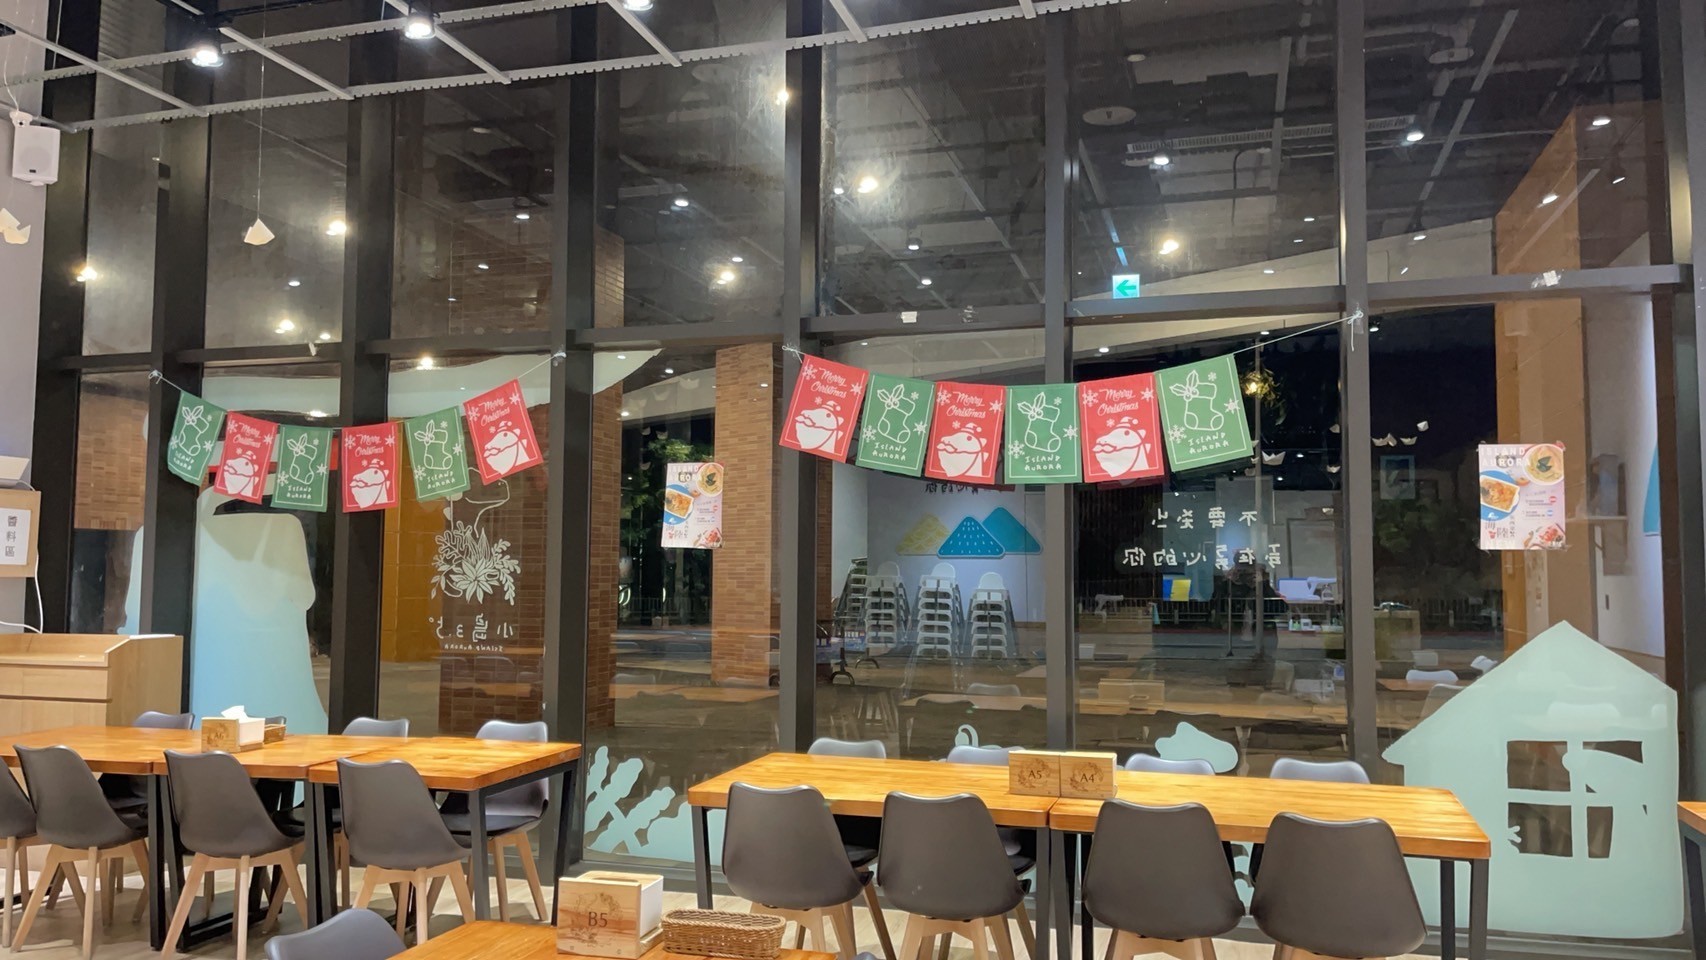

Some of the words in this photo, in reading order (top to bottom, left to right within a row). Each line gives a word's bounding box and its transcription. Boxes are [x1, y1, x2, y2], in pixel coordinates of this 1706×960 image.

[819, 367, 848, 387] Merry
[810, 381, 848, 398] Christmas
[1098, 388, 1135, 401] Merry
[479, 398, 507, 413] Merry
[952, 392, 985, 407] Merry
[946, 406, 986, 419] Christmas
[1097, 402, 1139, 416] Christmas
[480, 407, 511, 426] Christmas
[356, 434, 382, 444] Merry
[355, 446, 384, 456] Christmas
[1028, 770, 1042, 780] A5
[1080, 773, 1094, 782] A4
[588, 912, 608, 928] B5
